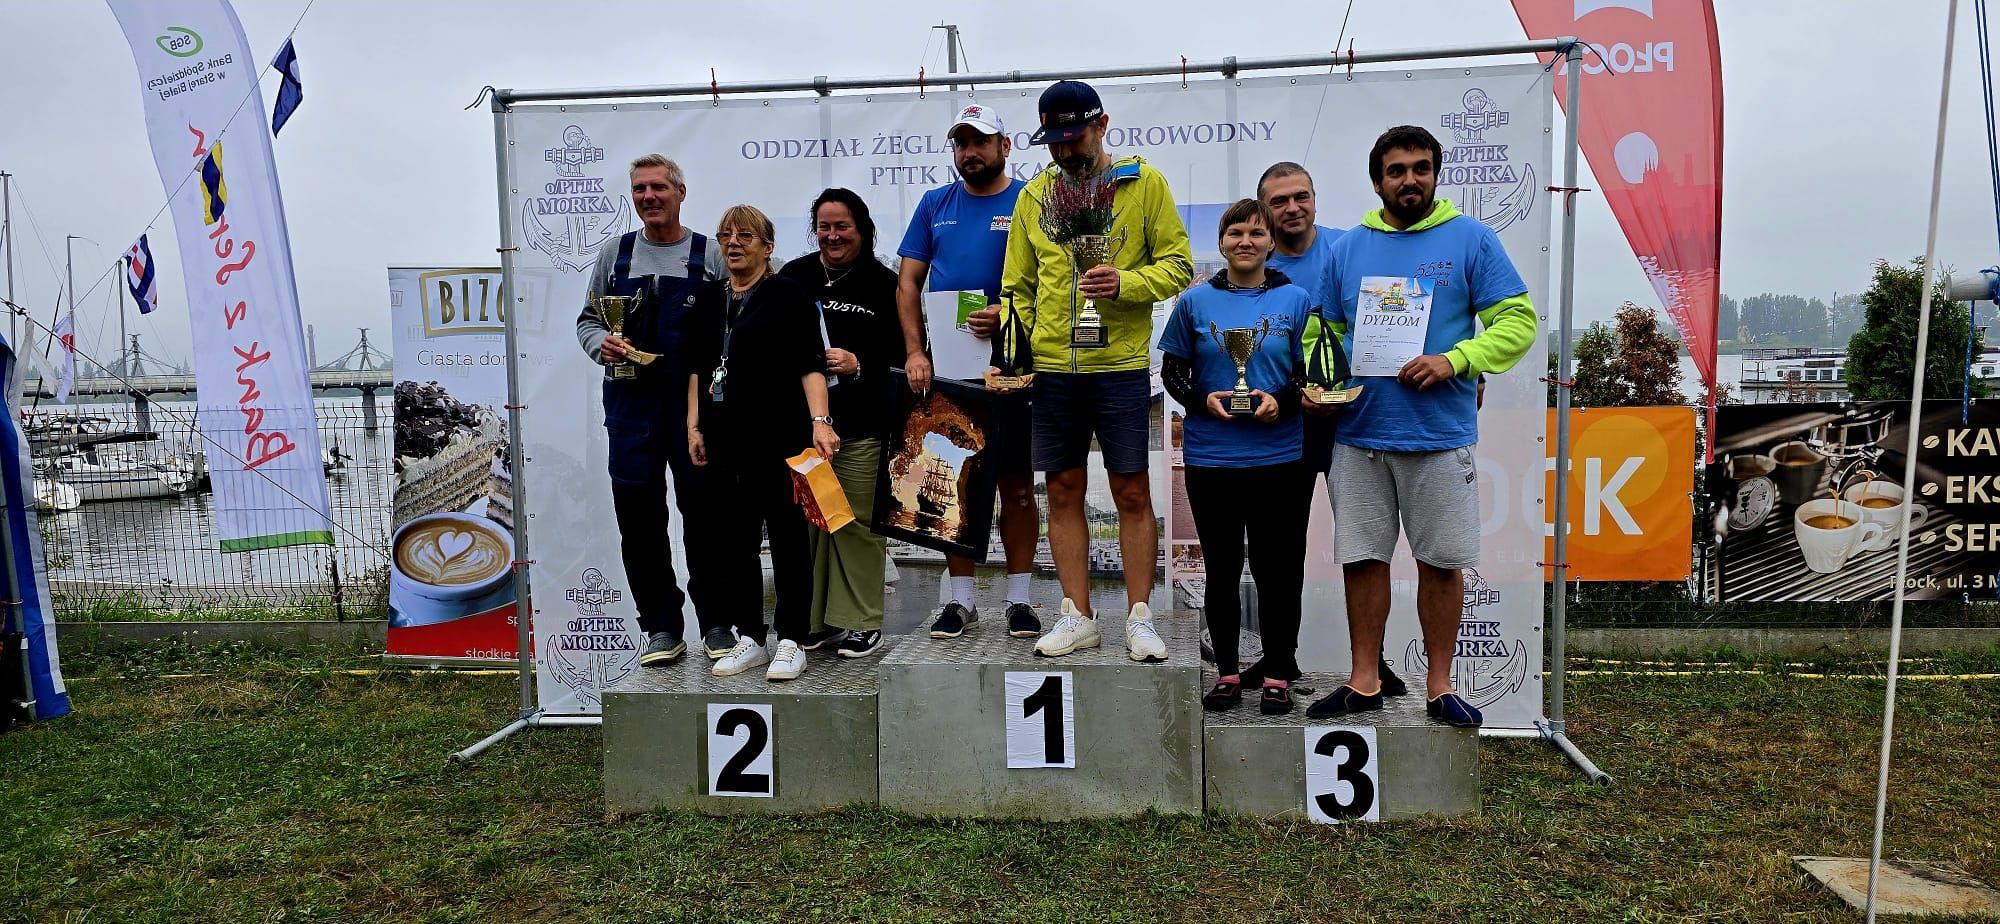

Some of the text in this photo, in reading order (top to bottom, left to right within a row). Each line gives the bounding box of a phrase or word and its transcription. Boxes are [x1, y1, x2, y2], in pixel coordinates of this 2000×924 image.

[741, 138, 864, 159] ODDZIAŁ
[1441, 145, 1508, 164] o/PTTK
[870, 161, 1044, 186] PTTK MKA
[545, 178, 604, 195] o/PTTK
[537, 196, 615, 215] MORKA
[1363, 314, 1422, 327] DYPLOM
[417, 350, 474, 366] Ciasta
[1889, 574, 1940, 590] Pock,
[1947, 574, 1968, 588] ul.
[1972, 574, 1984, 588] 3
[568, 617, 625, 631] o/PTTK
[560, 634, 635, 650] MORKA
[1023, 676, 1064, 764] 1
[715, 708, 770, 794] 2
[1314, 730, 1376, 821] 3
